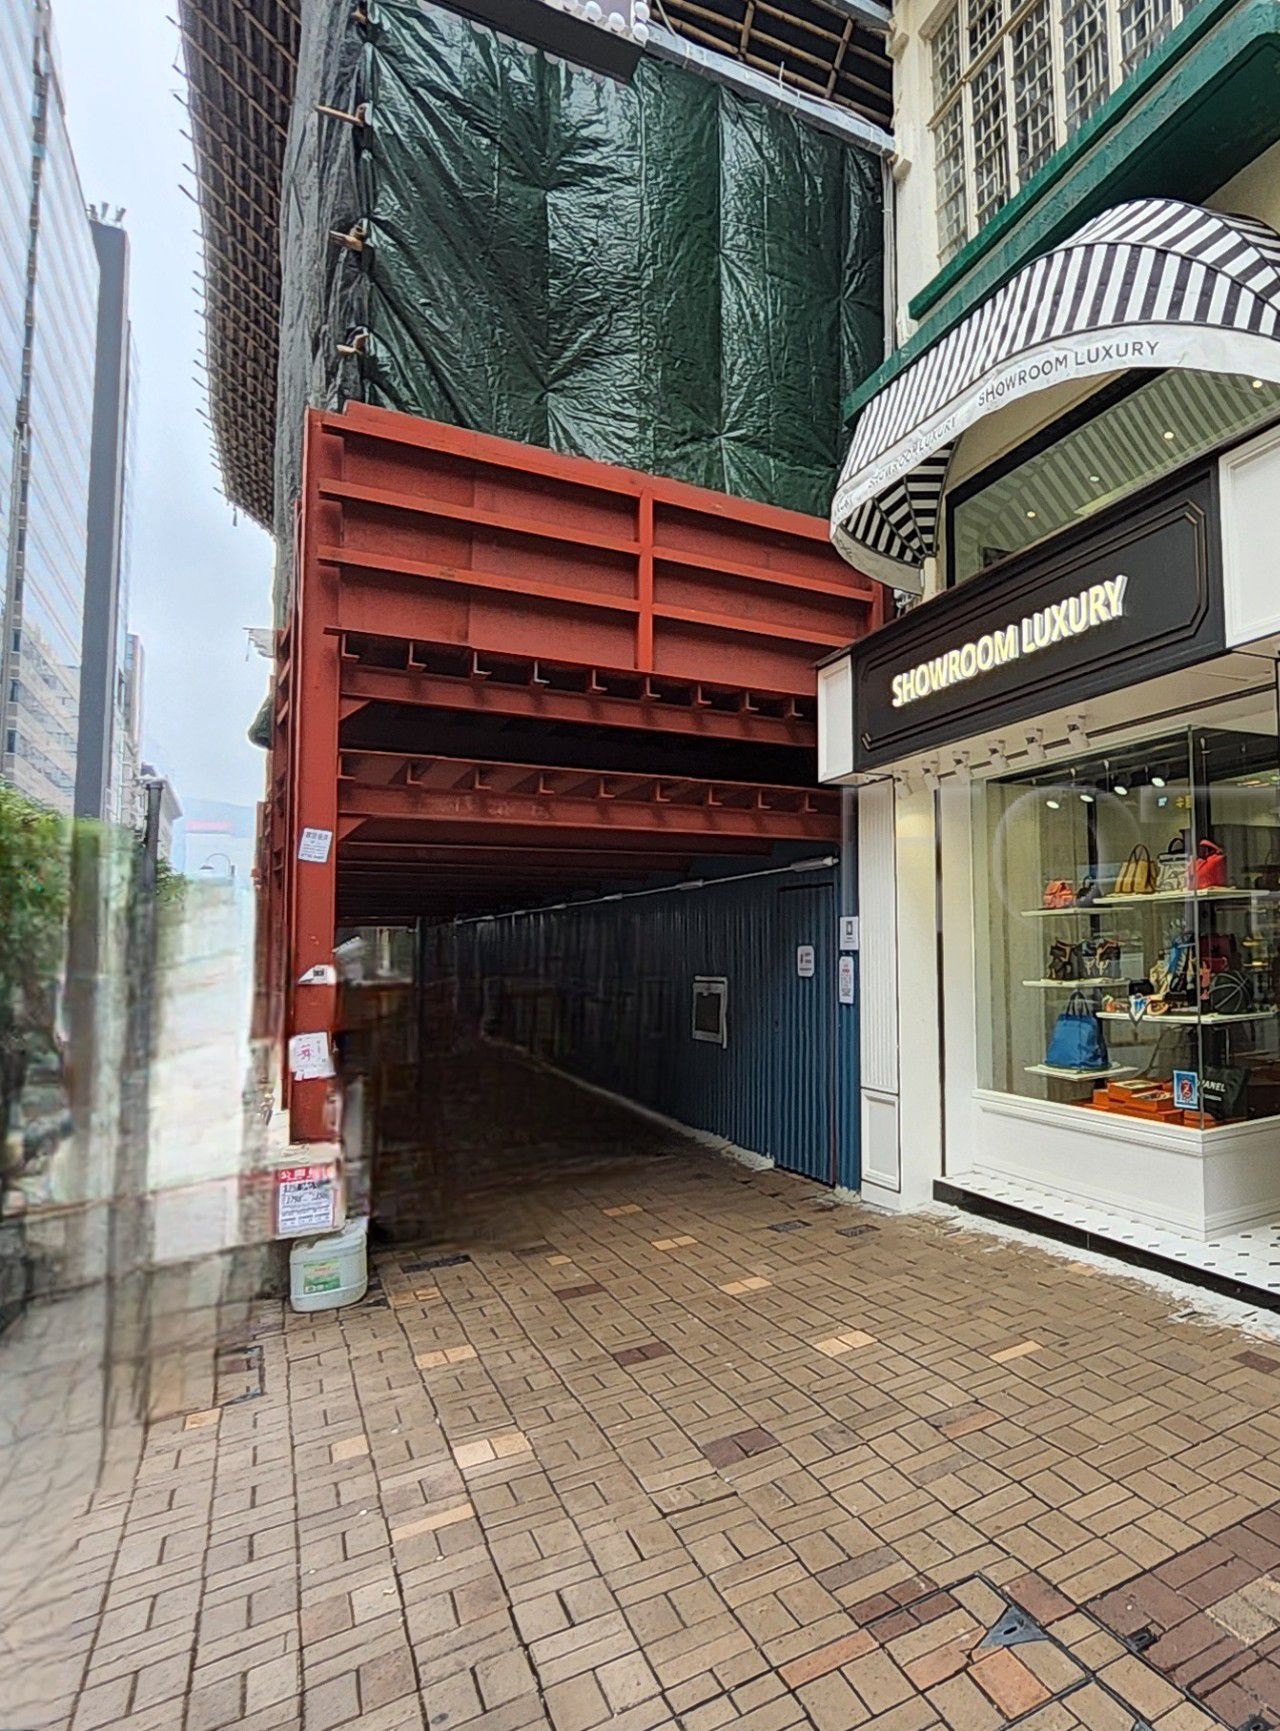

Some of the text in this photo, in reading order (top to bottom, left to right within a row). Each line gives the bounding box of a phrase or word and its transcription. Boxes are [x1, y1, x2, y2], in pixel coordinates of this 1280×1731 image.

[977, 341, 1160, 408] SHOWROOM LUXURY
[891, 574, 1128, 708] SHOWROOM LUXURY
